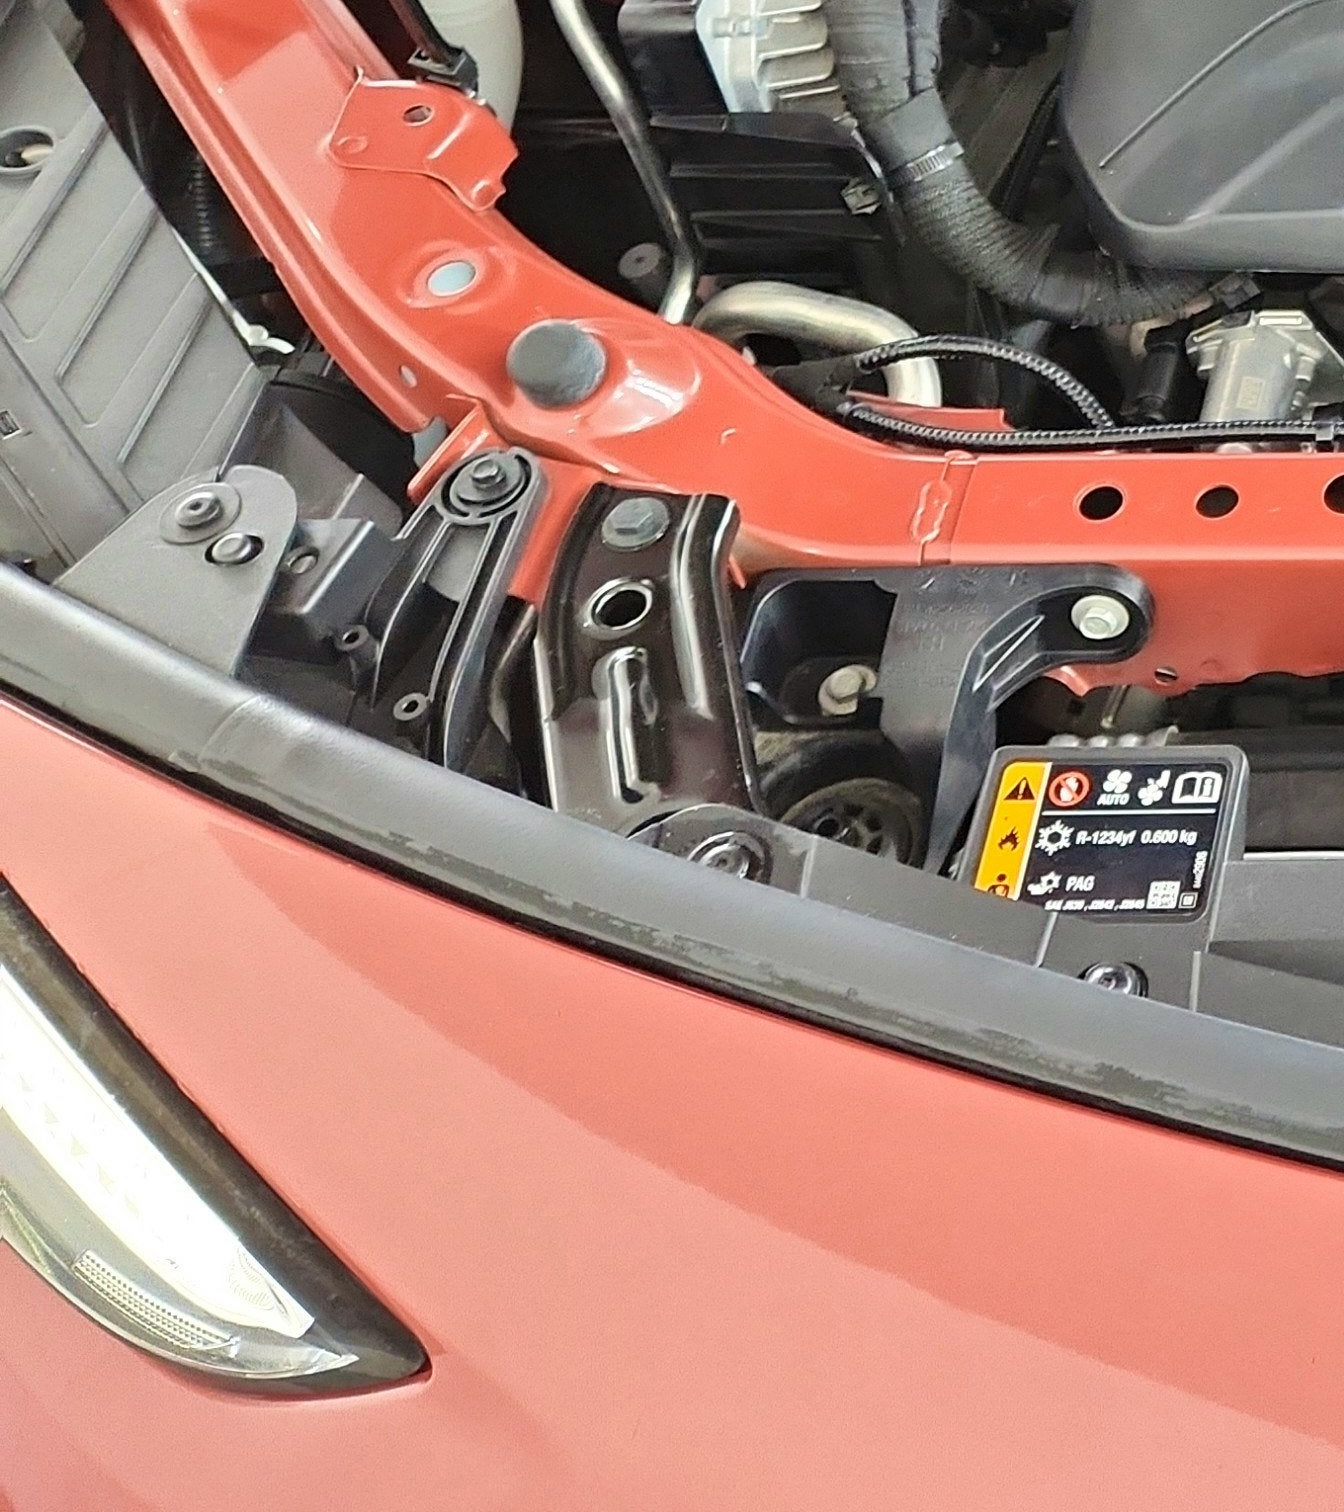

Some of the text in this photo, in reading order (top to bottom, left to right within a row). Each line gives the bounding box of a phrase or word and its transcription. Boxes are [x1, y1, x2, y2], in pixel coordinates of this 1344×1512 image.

[1097, 792, 1130, 806] AUTO
[1178, 829, 1198, 846] kg
[1066, 875, 1095, 892] PAG
